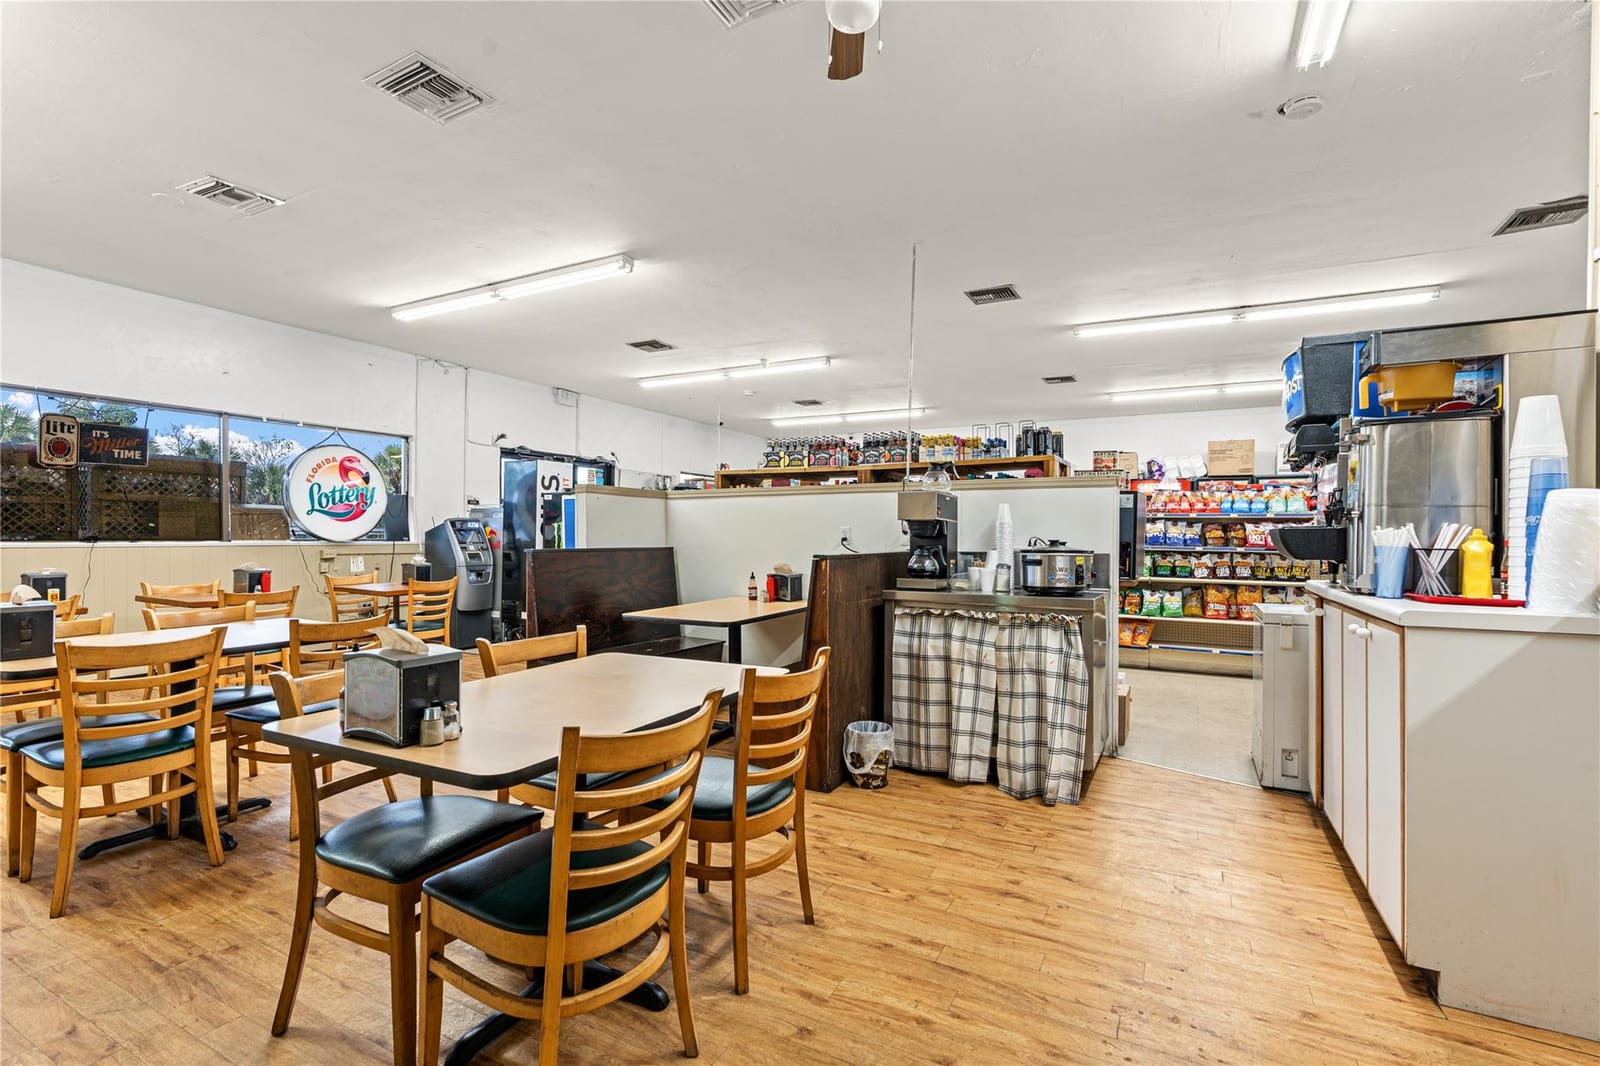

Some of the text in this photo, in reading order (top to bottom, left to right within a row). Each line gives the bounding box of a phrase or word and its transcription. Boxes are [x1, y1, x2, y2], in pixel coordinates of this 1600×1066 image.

[45, 420, 75, 436] Lite
[92, 430, 109, 438] IT'S
[81, 437, 141, 455] Miller
[112, 449, 142, 459] TIME
[306, 456, 338, 484] FLORIDA
[306, 482, 376, 518] Lottery
